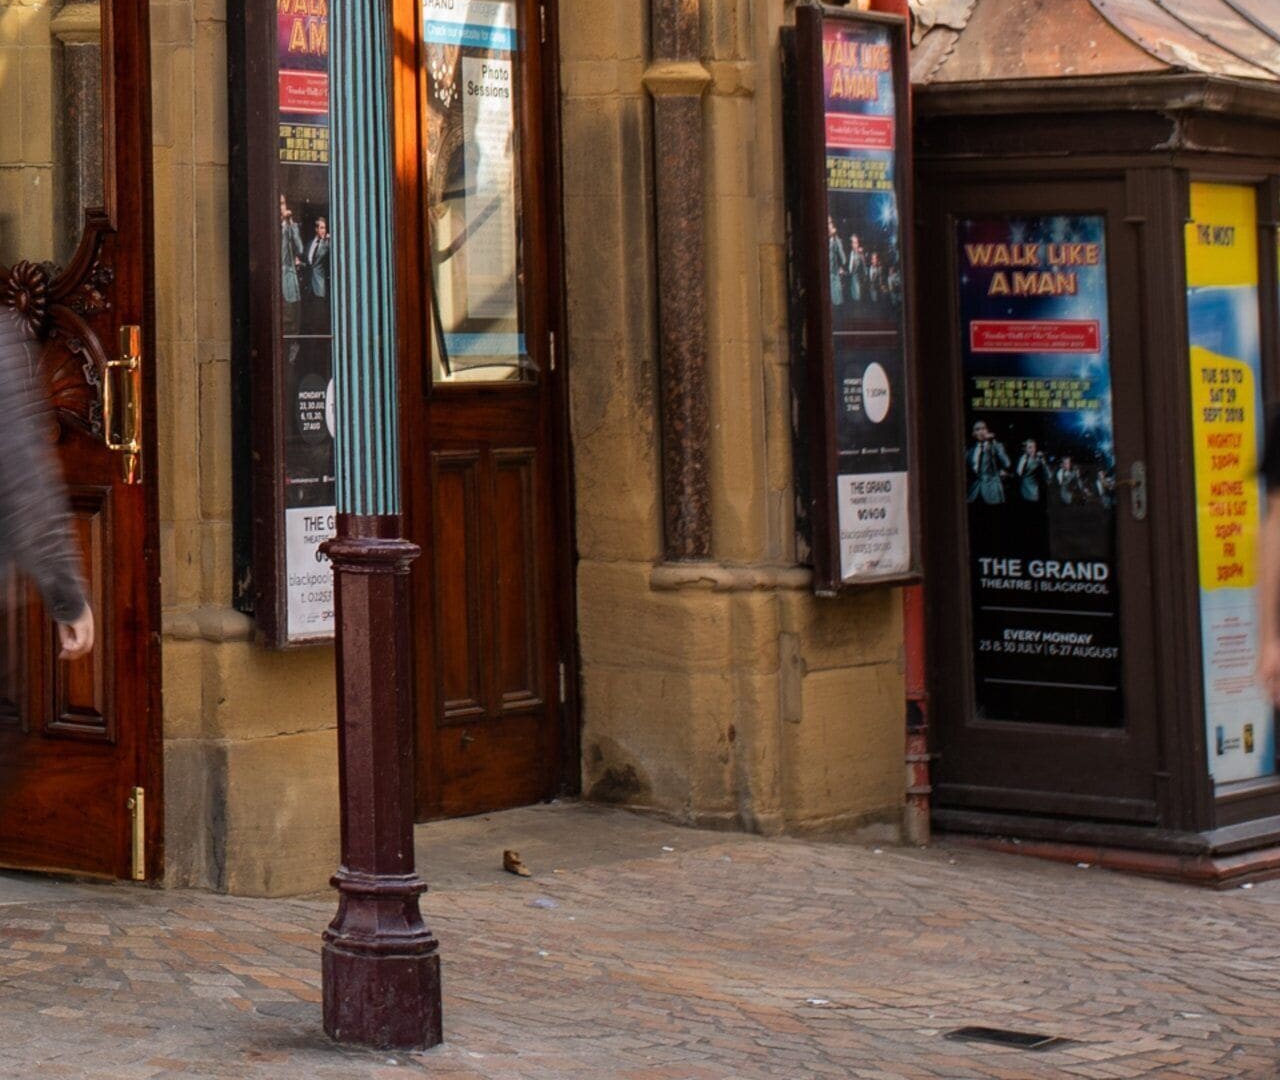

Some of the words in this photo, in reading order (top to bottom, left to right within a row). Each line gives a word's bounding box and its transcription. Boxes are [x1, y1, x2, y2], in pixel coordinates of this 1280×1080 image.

[860, 42, 891, 72] LIKE
[482, 64, 509, 80] Photo
[467, 80, 510, 98] Sessions
[1196, 223, 1211, 245] THE
[1213, 225, 1235, 247] MOST
[965, 242, 1040, 266] WALK
[1047, 242, 1100, 267] LIKE
[988, 271, 1010, 296] A
[1013, 271, 1078, 297] MAN
[1201, 368, 1217, 384] TUE
[1232, 369, 1243, 384] TO
[1209, 388, 1224, 404] SAT
[1202, 407, 1223, 423] SEPT
[1206, 432, 1243, 449] NIGHTLY
[850, 481, 865, 495] THE
[866, 479, 892, 494] GRAND
[303, 516, 325, 532] THE
[978, 557, 1022, 577] THE
[1028, 560, 1109, 581] GRAND
[980, 578, 1031, 591] THEATRE
[1041, 581, 1109, 594] BLACKPOOL
[1003, 629, 1040, 641] EVERY
[1042, 631, 1093, 644] MONDAY
[1017, 642, 1042, 655] JULY
[1072, 646, 1118, 658] AUGUST
